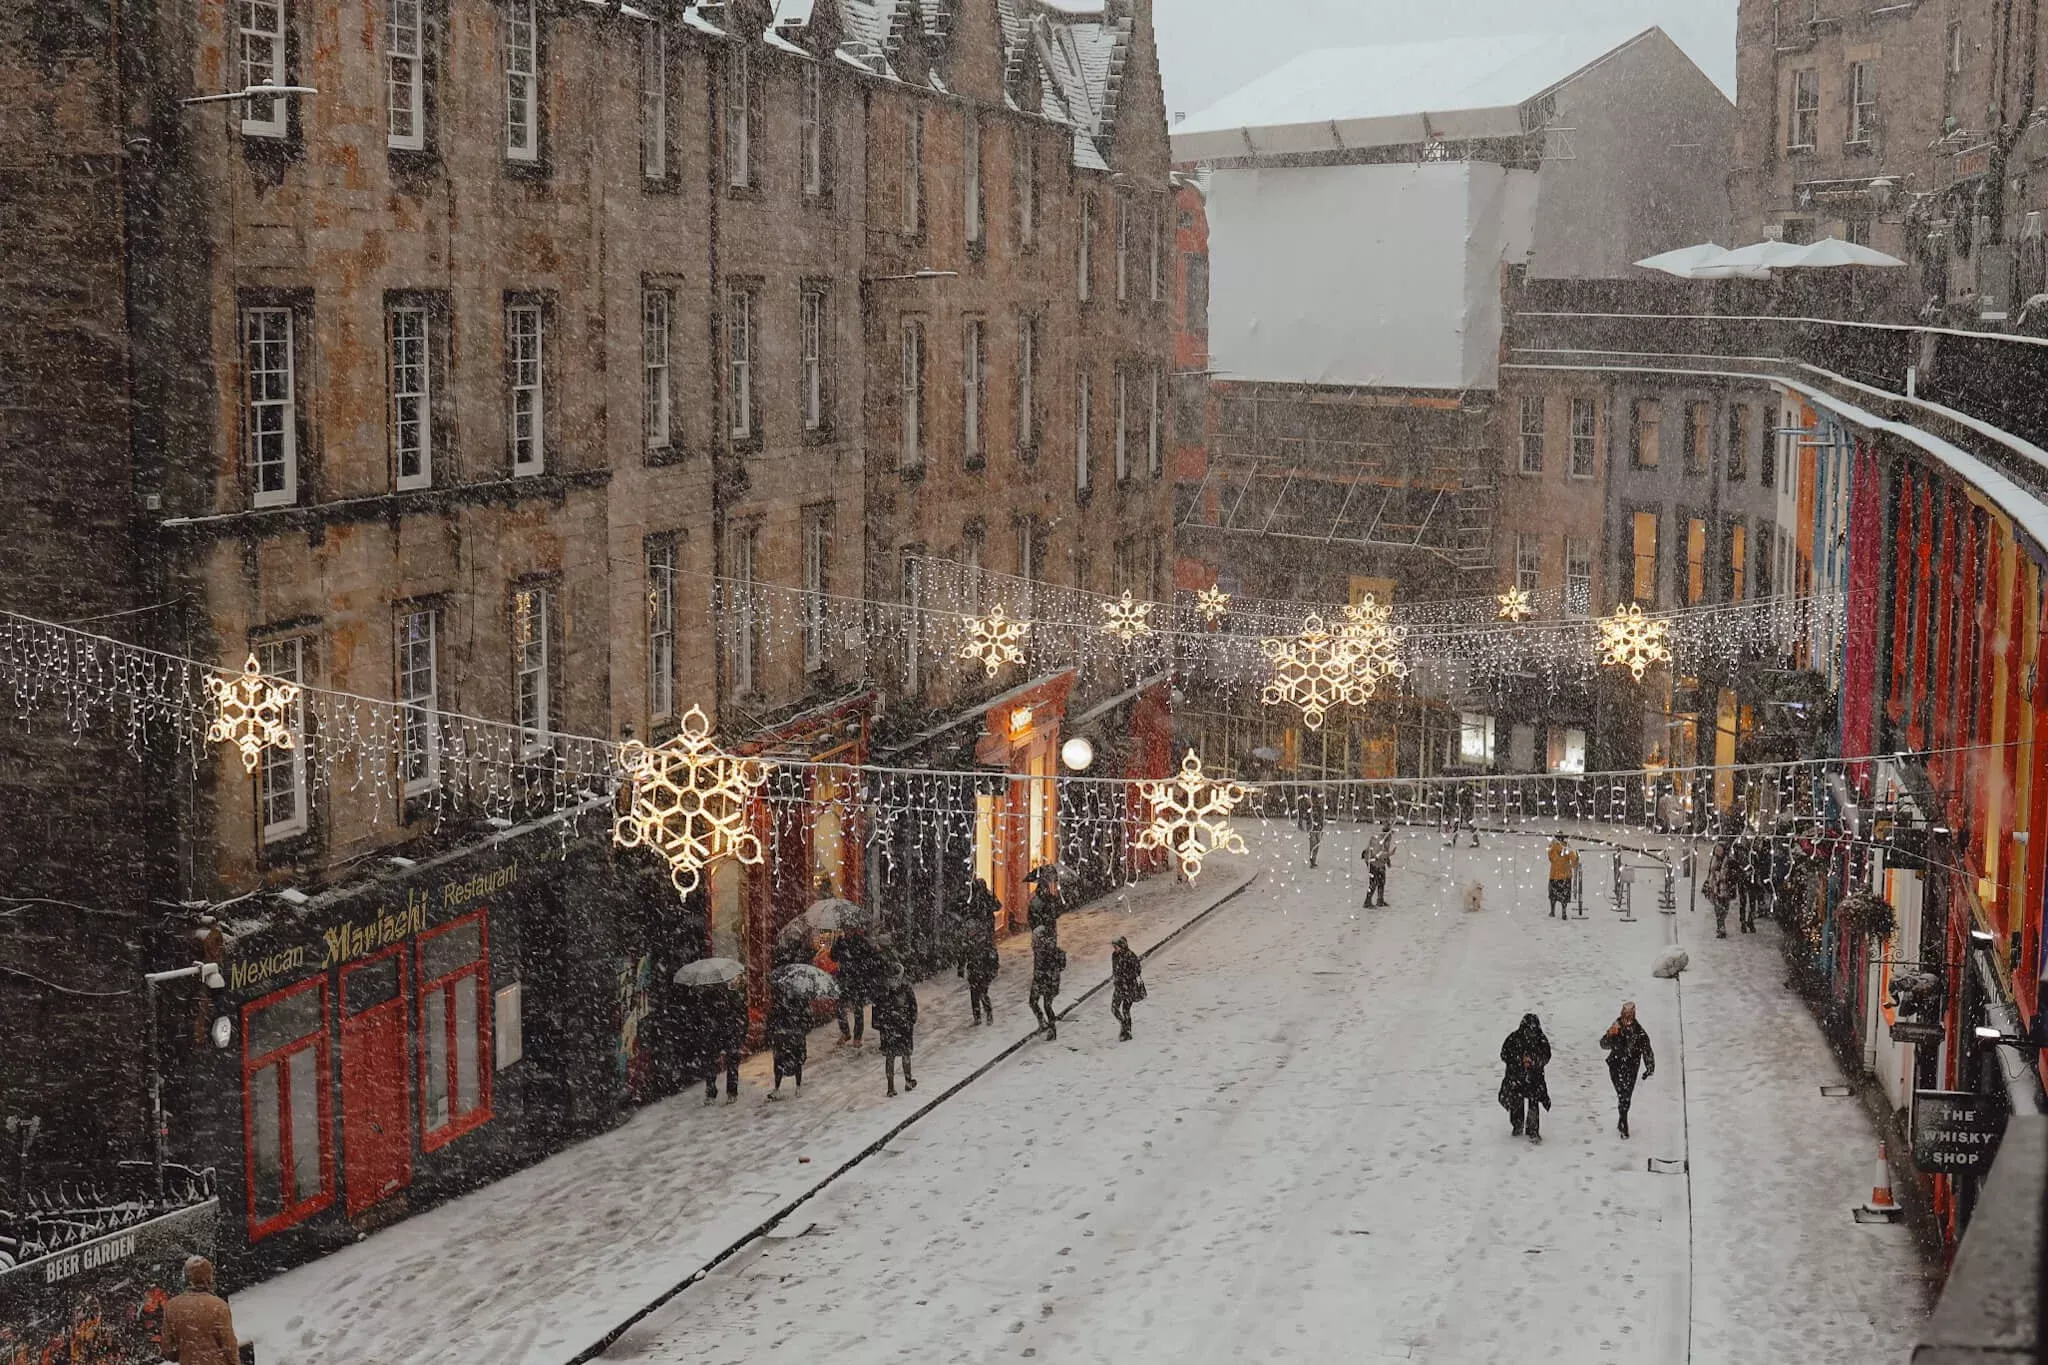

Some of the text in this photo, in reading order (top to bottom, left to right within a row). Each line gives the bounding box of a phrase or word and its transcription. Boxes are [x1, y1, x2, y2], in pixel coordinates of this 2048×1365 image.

[231, 860, 518, 990] Mexican Mariachi Restaurant
[1942, 1110, 1975, 1121] THE
[1924, 1131, 1992, 1143] WHISKY
[1933, 1152, 1978, 1164] SHOP
[46, 1235, 135, 1283] BEER GARDEN
